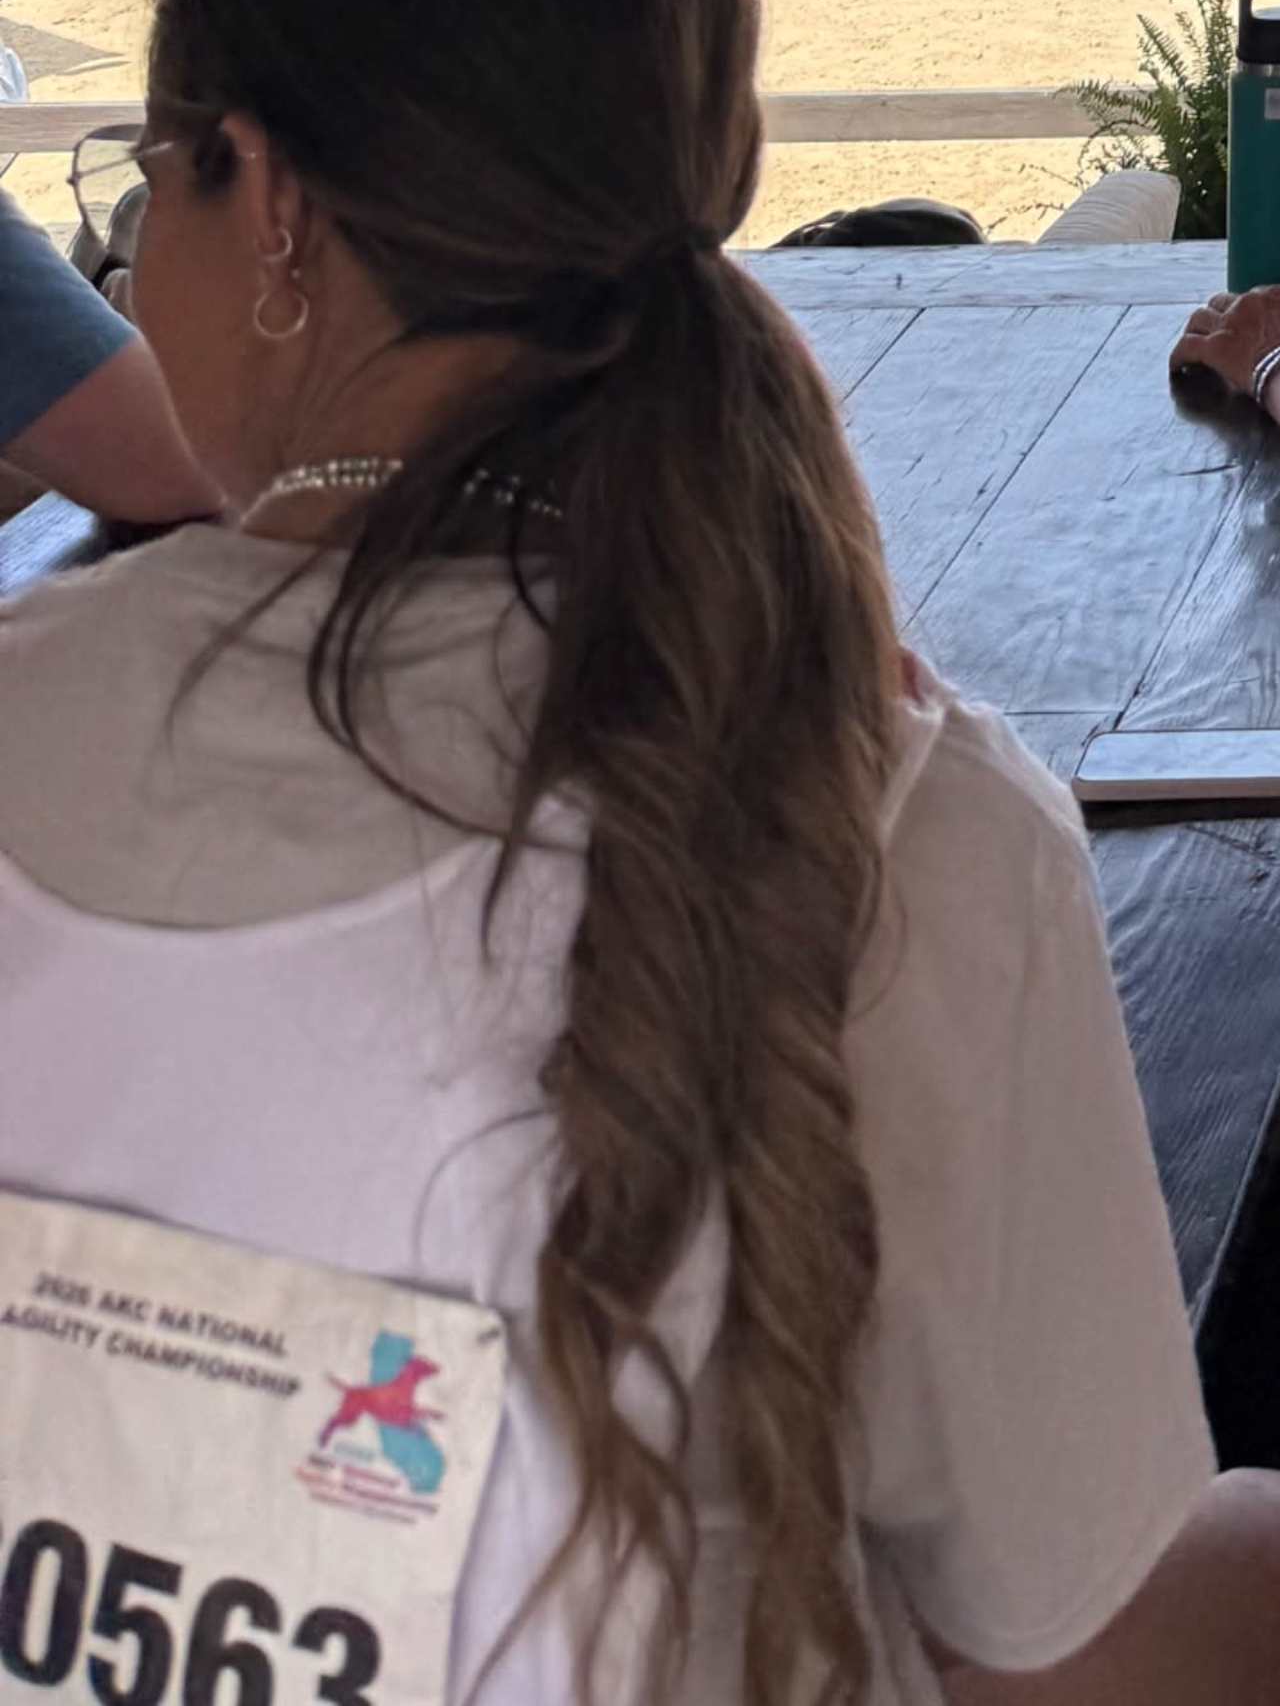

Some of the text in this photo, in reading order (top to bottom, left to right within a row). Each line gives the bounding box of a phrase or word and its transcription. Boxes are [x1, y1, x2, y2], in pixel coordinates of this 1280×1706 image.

[0, 1303, 302, 1399] AGILITY CHAMPIONSHIP
[98, 1291, 151, 1322] AKC
[157, 1305, 287, 1358] NATIONAL
[0, 1518, 382, 1706] 0563
